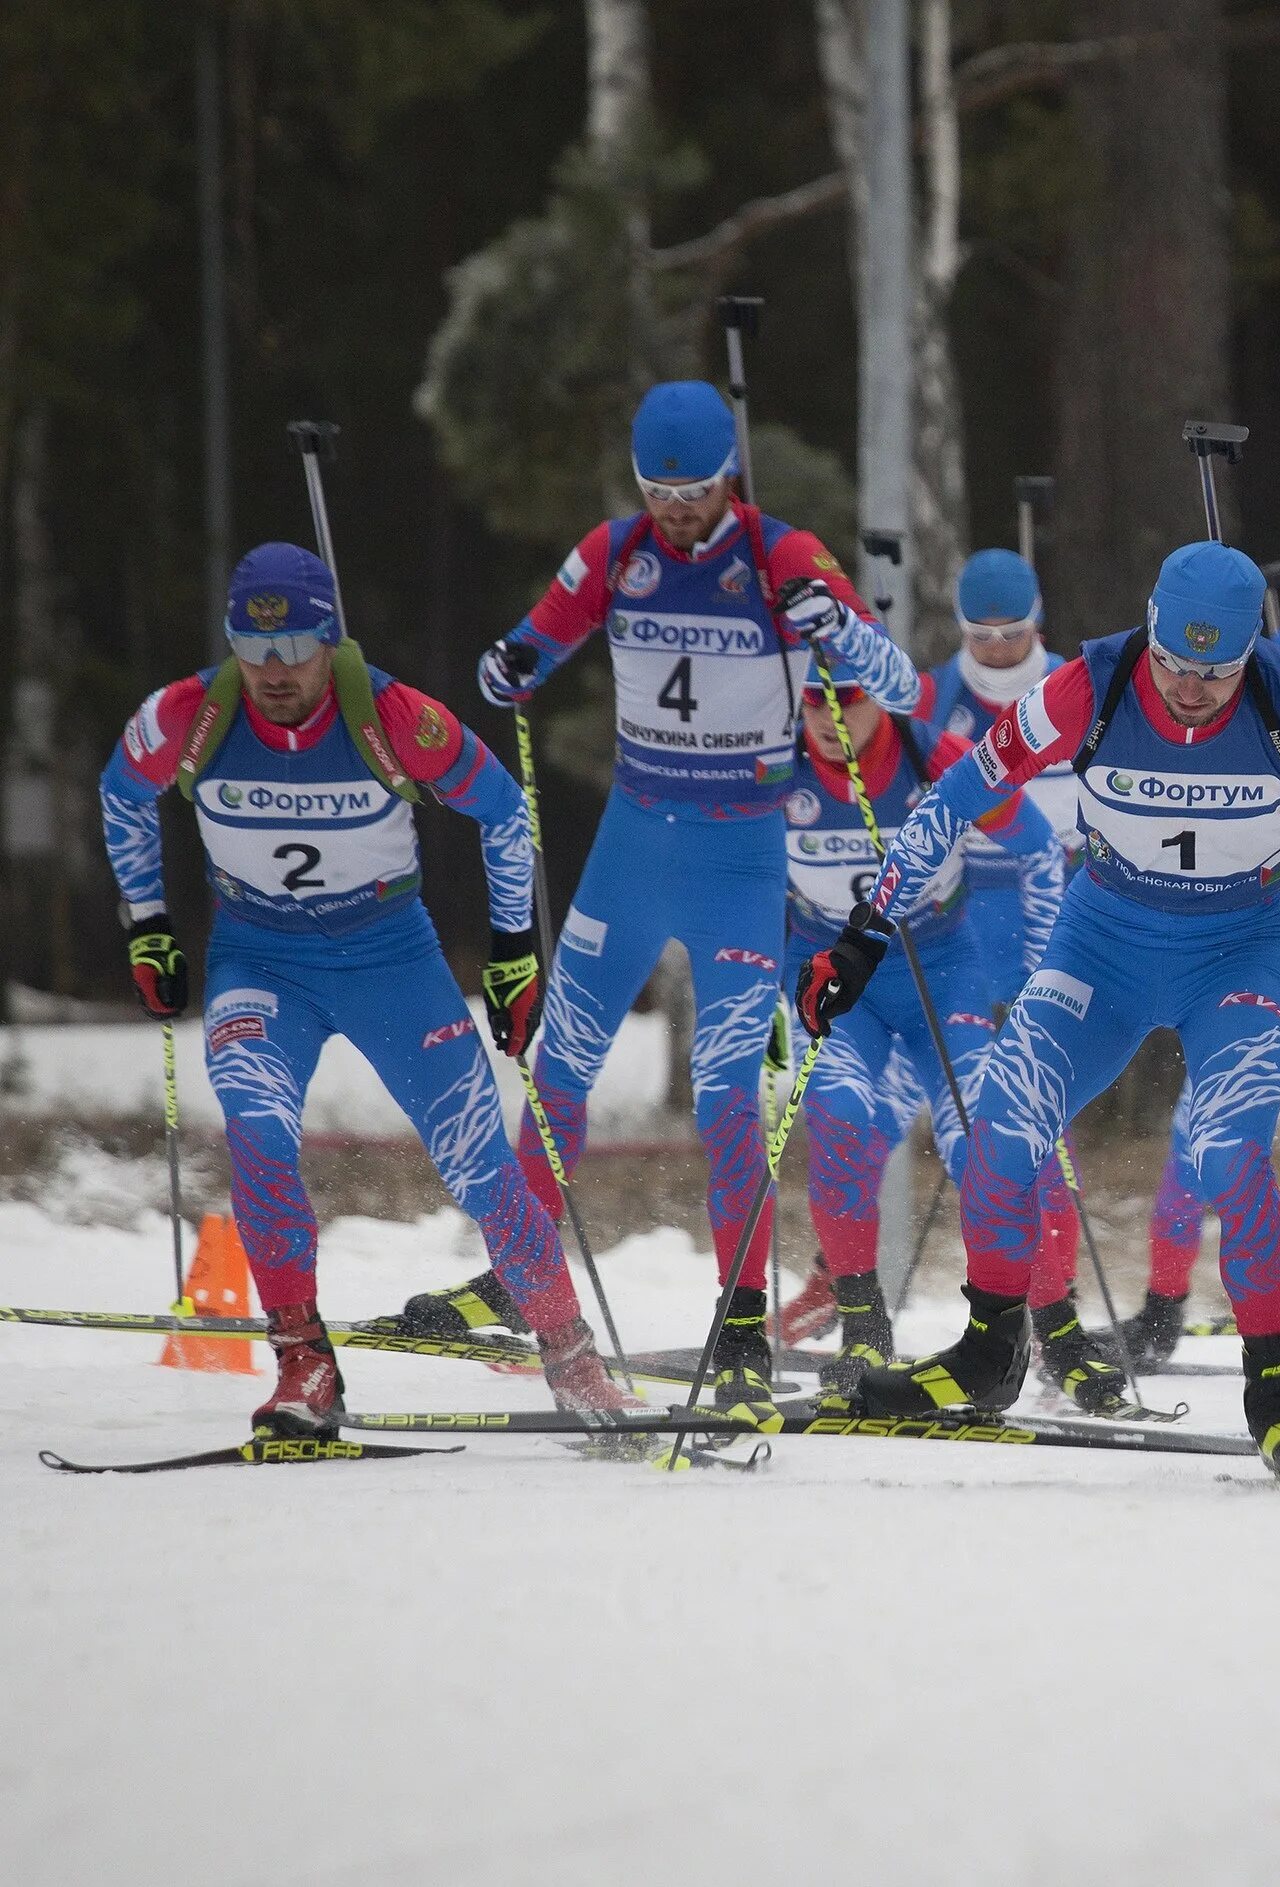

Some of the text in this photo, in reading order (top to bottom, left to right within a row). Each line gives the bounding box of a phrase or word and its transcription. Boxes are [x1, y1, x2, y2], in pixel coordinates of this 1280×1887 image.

[632, 618, 762, 652] Фортум
[657, 655, 698, 723] 4
[701, 729, 765, 750] СИБИРИ
[247, 786, 372, 817] Фортум
[1138, 776, 1265, 807] Фортум
[1161, 830, 1196, 871] 1
[272, 842, 326, 892] 2
[1114, 857, 1191, 891] ТЮМЕНСКАЯ
[1029, 985, 1085, 1015] GAZPROM
[345, 1334, 530, 1364] FISCHER
[362, 1412, 511, 1427] FISCHER
[803, 1417, 1038, 1445] FISCHER
[261, 1439, 363, 1460] FISCHER
